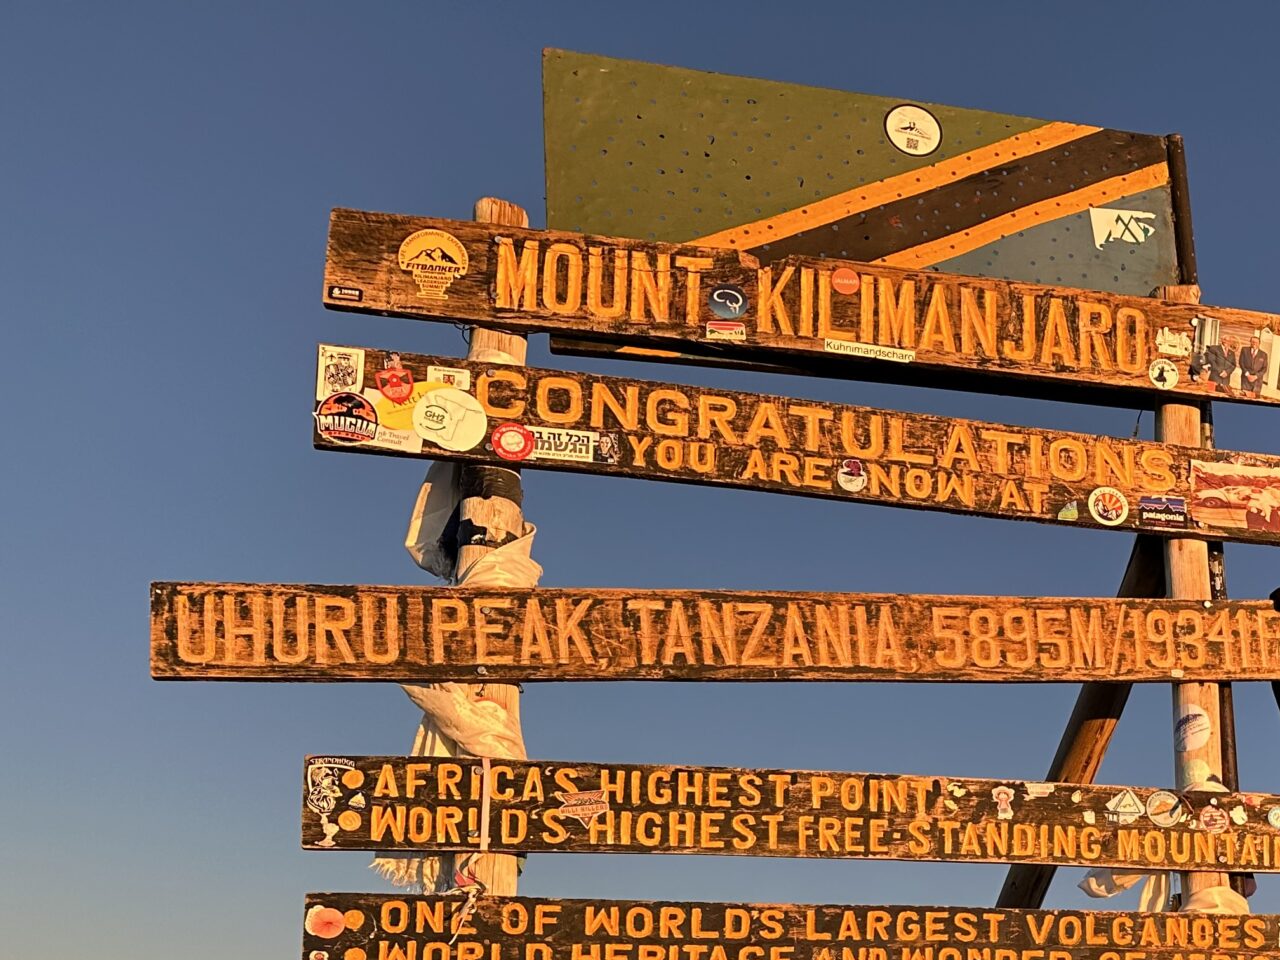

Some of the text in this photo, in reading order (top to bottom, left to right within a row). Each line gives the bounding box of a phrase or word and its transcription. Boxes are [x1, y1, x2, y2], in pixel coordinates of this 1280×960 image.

[405, 262, 461, 273] FITBANKER
[496, 237, 1147, 374] MOUNT KILIMANJARO
[424, 410, 446, 422] GH2
[476, 369, 1177, 491] CONGRATULATIONS
[628, 434, 716, 473] YOU
[741, 448, 832, 489] ARE
[869, 463, 976, 506] NOW
[1000, 478, 1050, 515] AT
[1143, 511, 1185, 522] patagonia
[177, 595, 400, 663] UHURU
[373, 763, 934, 814] AFRICA'S HIGHEST POINT
[370, 805, 572, 845] WORLD'S
[589, 811, 786, 851] HIGHEST
[381, 900, 1266, 948] ONE OF WORLD'S LARGEST VOLCANOES
